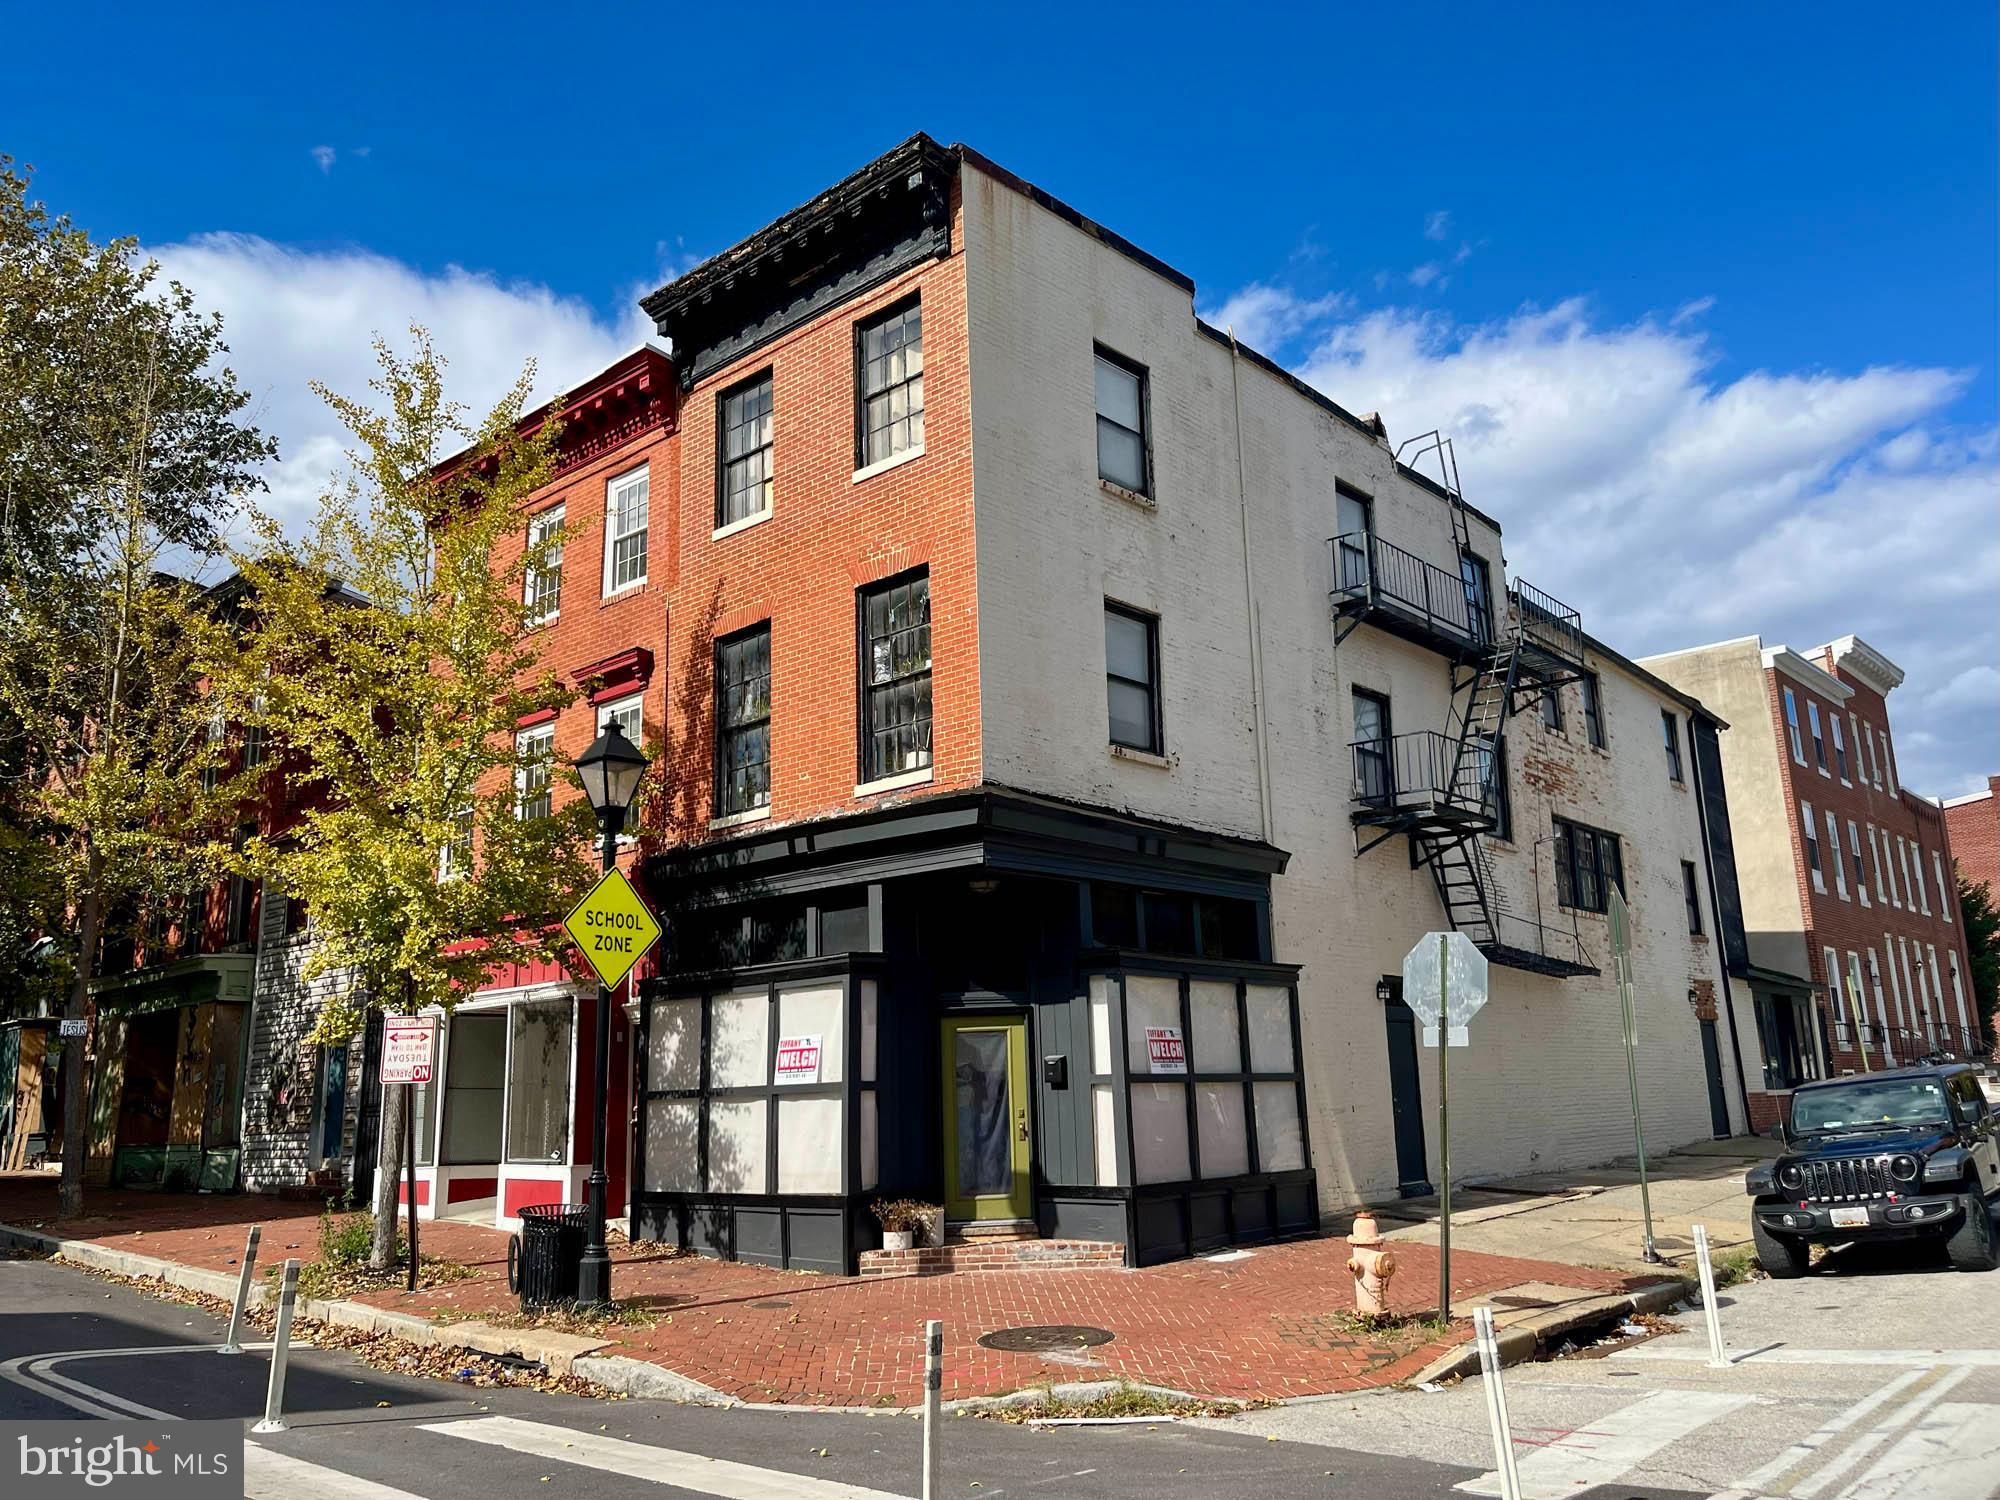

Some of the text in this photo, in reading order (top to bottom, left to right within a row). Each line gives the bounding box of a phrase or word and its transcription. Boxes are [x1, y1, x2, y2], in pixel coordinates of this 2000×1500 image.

[585, 910, 643, 930] SCHOOL
[594, 934, 632, 952] ZONE
[63, 1024, 87, 1036] JESUS
[780, 1039, 801, 1048] TIFFANY
[1150, 1041, 1183, 1057] WELCH
[387, 1053, 428, 1062] TUESDAY
[779, 1050, 817, 1068] WELCH
[384, 1066, 429, 1079] NO PARKING
